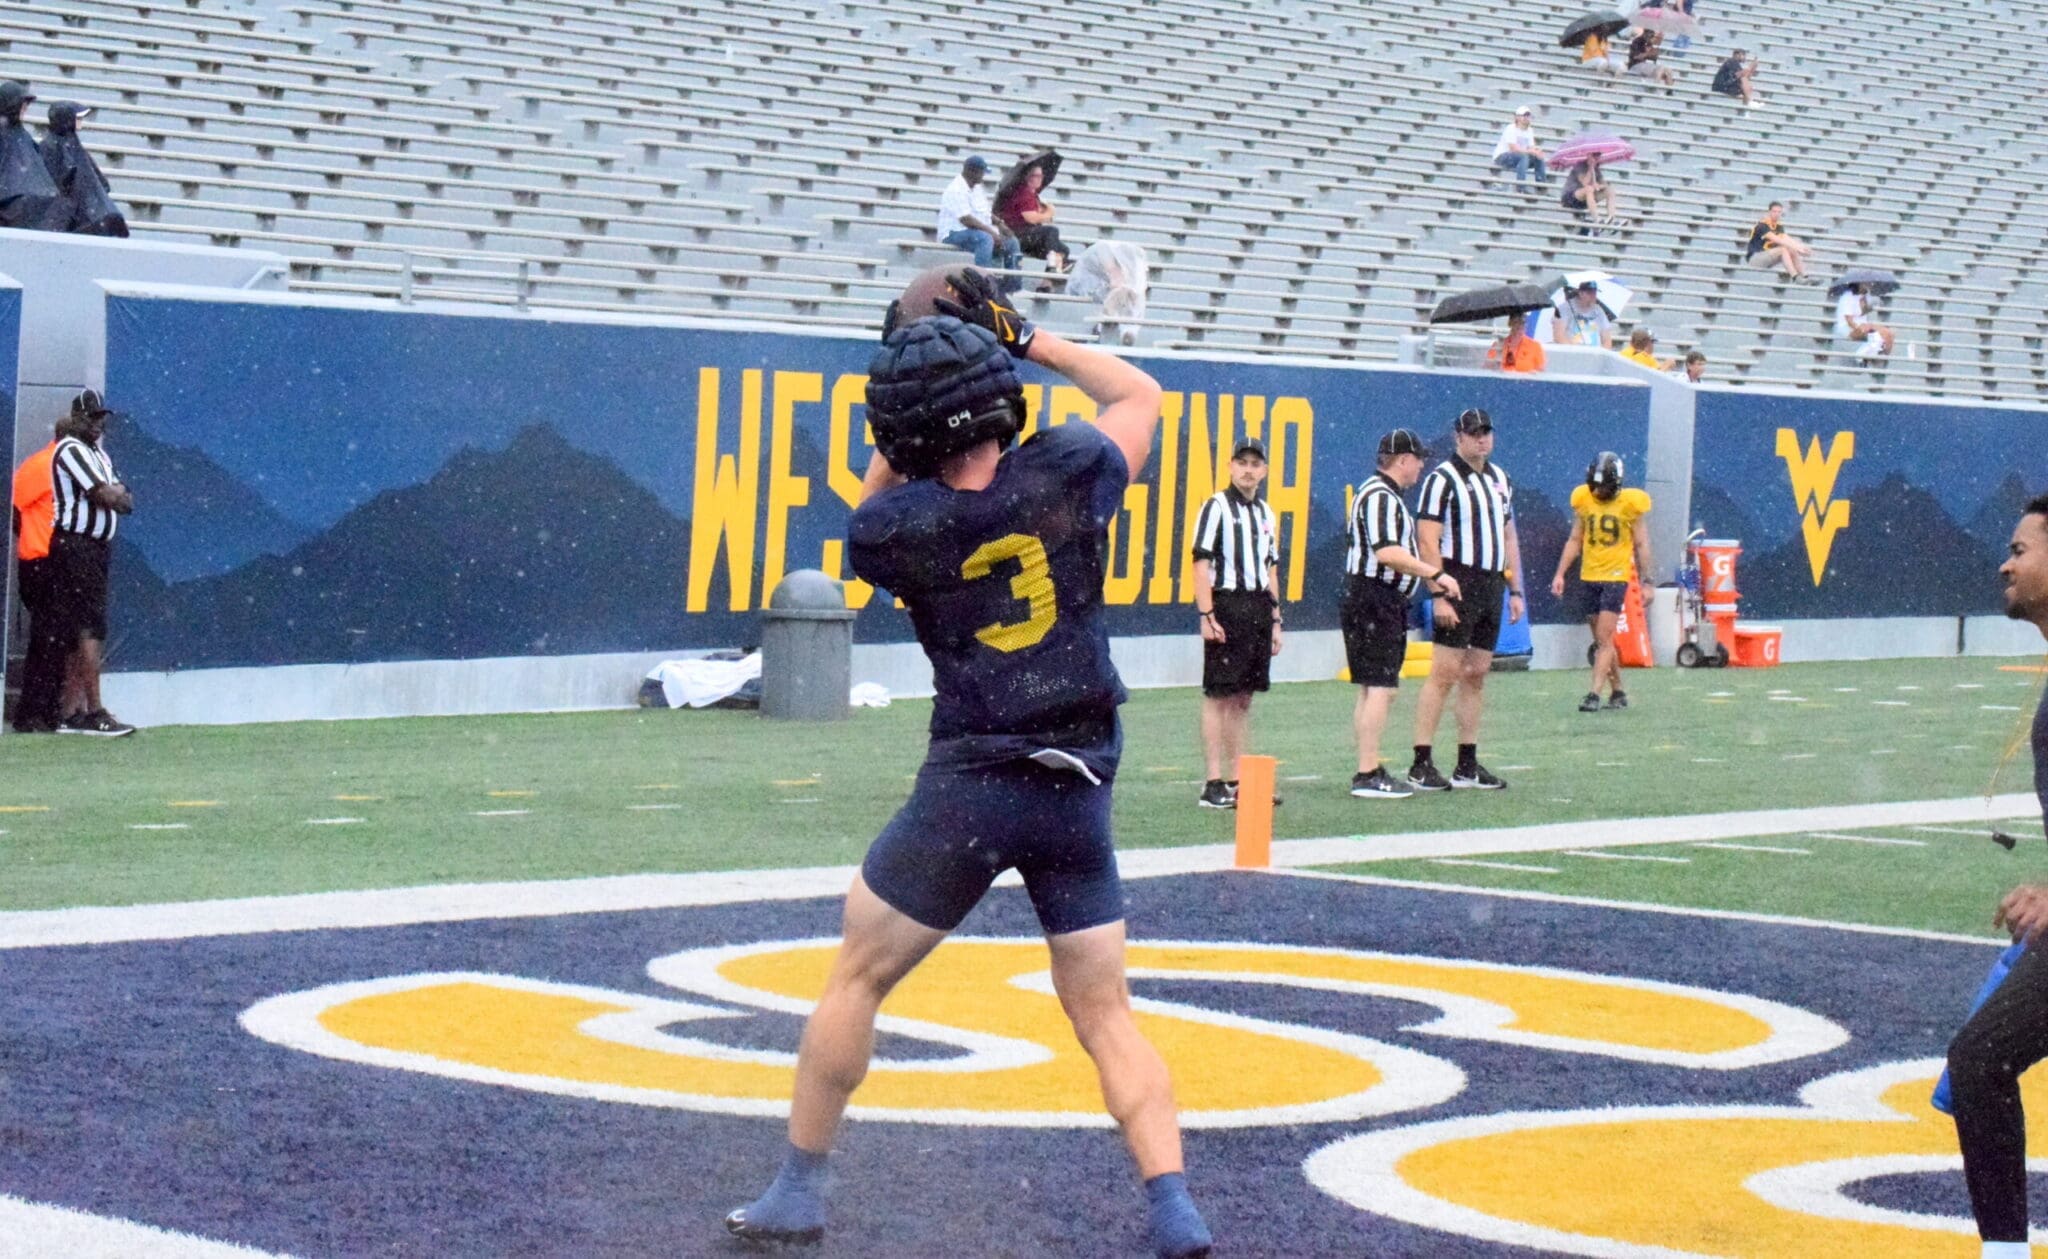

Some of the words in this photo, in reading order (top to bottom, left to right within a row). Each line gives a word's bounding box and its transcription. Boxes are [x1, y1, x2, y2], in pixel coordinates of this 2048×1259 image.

[687, 367, 906, 613] WES
[1587, 514, 1620, 547] 19
[1713, 555, 1731, 575] G
[961, 532, 1058, 653] 3
[1763, 638, 1776, 661] G
